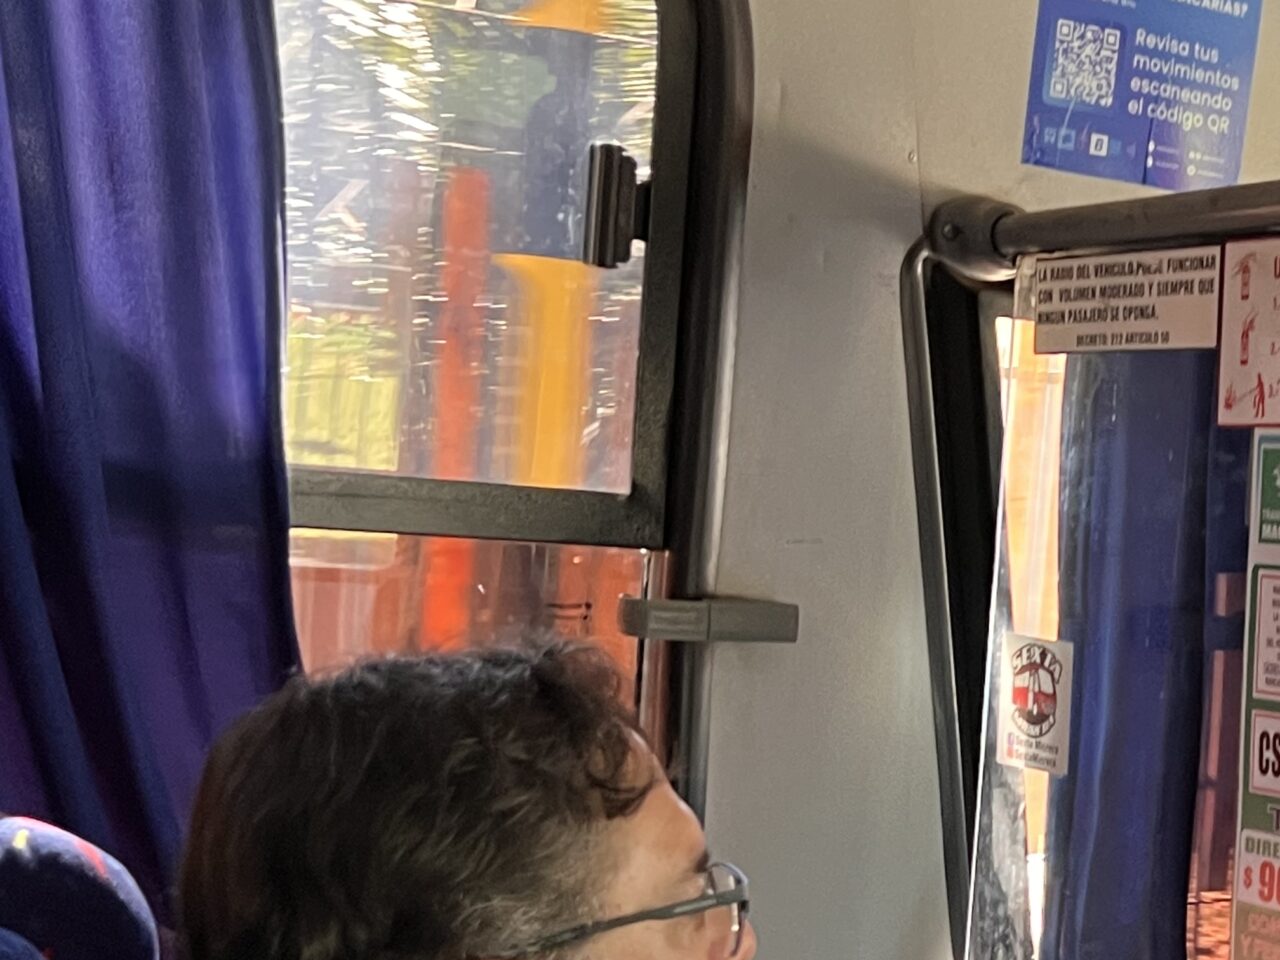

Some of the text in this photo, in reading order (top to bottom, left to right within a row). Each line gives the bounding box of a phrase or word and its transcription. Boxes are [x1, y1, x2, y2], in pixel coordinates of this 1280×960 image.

[1136, 28, 1218, 64] Revisa tus
[1133, 54, 1239, 91] movimientos
[1130, 77, 1232, 112] escaneando
[1128, 98, 1229, 135] el código QR
[1038, 267, 1048, 283] LA
[1050, 265, 1074, 281] RADIO
[1076, 263, 1090, 280] DEL
[1094, 261, 1134, 278] VEHICULO
[1167, 254, 1216, 273] FUNCIONAR
[1038, 278, 1215, 305] CON VOLUMEN MODERADO Y SIEMPRE QUE
[1038, 309, 1066, 325] NINGUN
[1068, 306, 1108, 324] PASAJERO
[1110, 305, 1120, 321] SE
